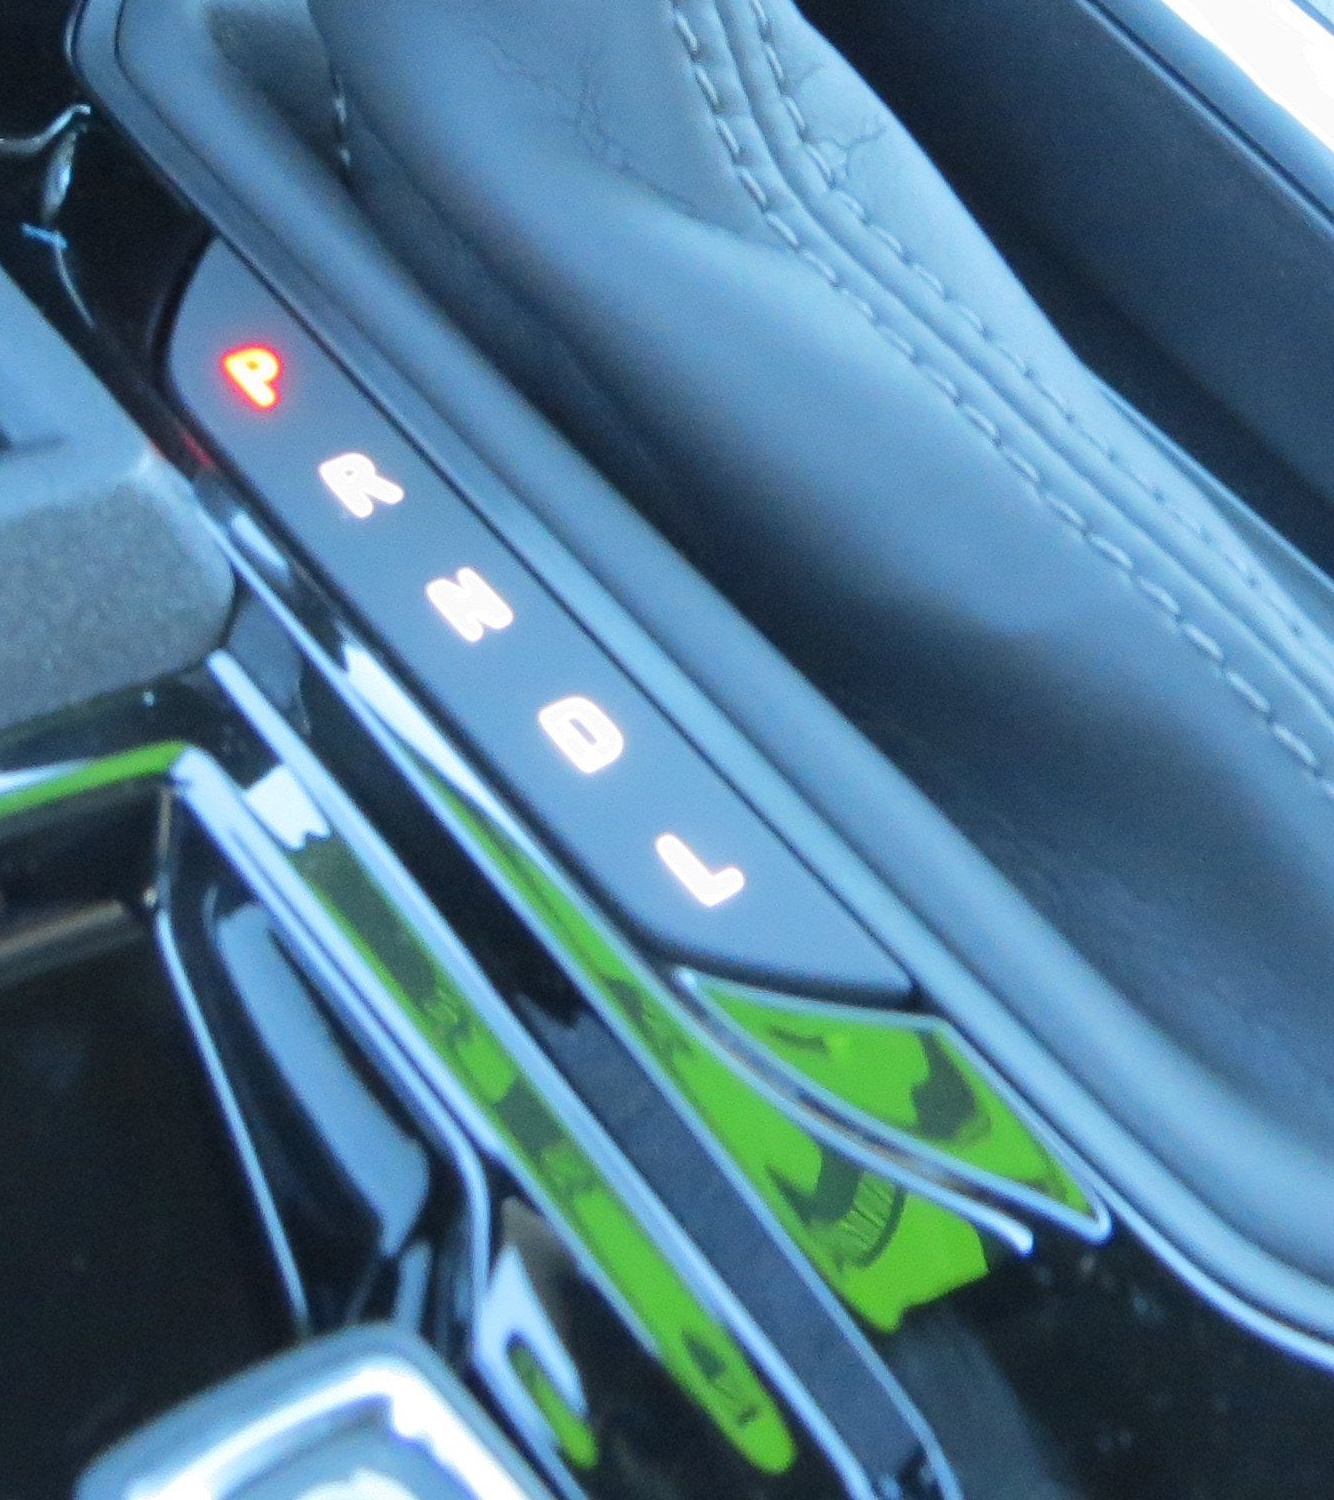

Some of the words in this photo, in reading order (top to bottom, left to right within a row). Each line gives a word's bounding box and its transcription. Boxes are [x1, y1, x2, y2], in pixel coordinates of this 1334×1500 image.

[220, 344, 282, 409] P
[318, 452, 405, 518] R
[425, 567, 514, 642] N
[537, 696, 624, 773] D
[655, 833, 745, 906] L
